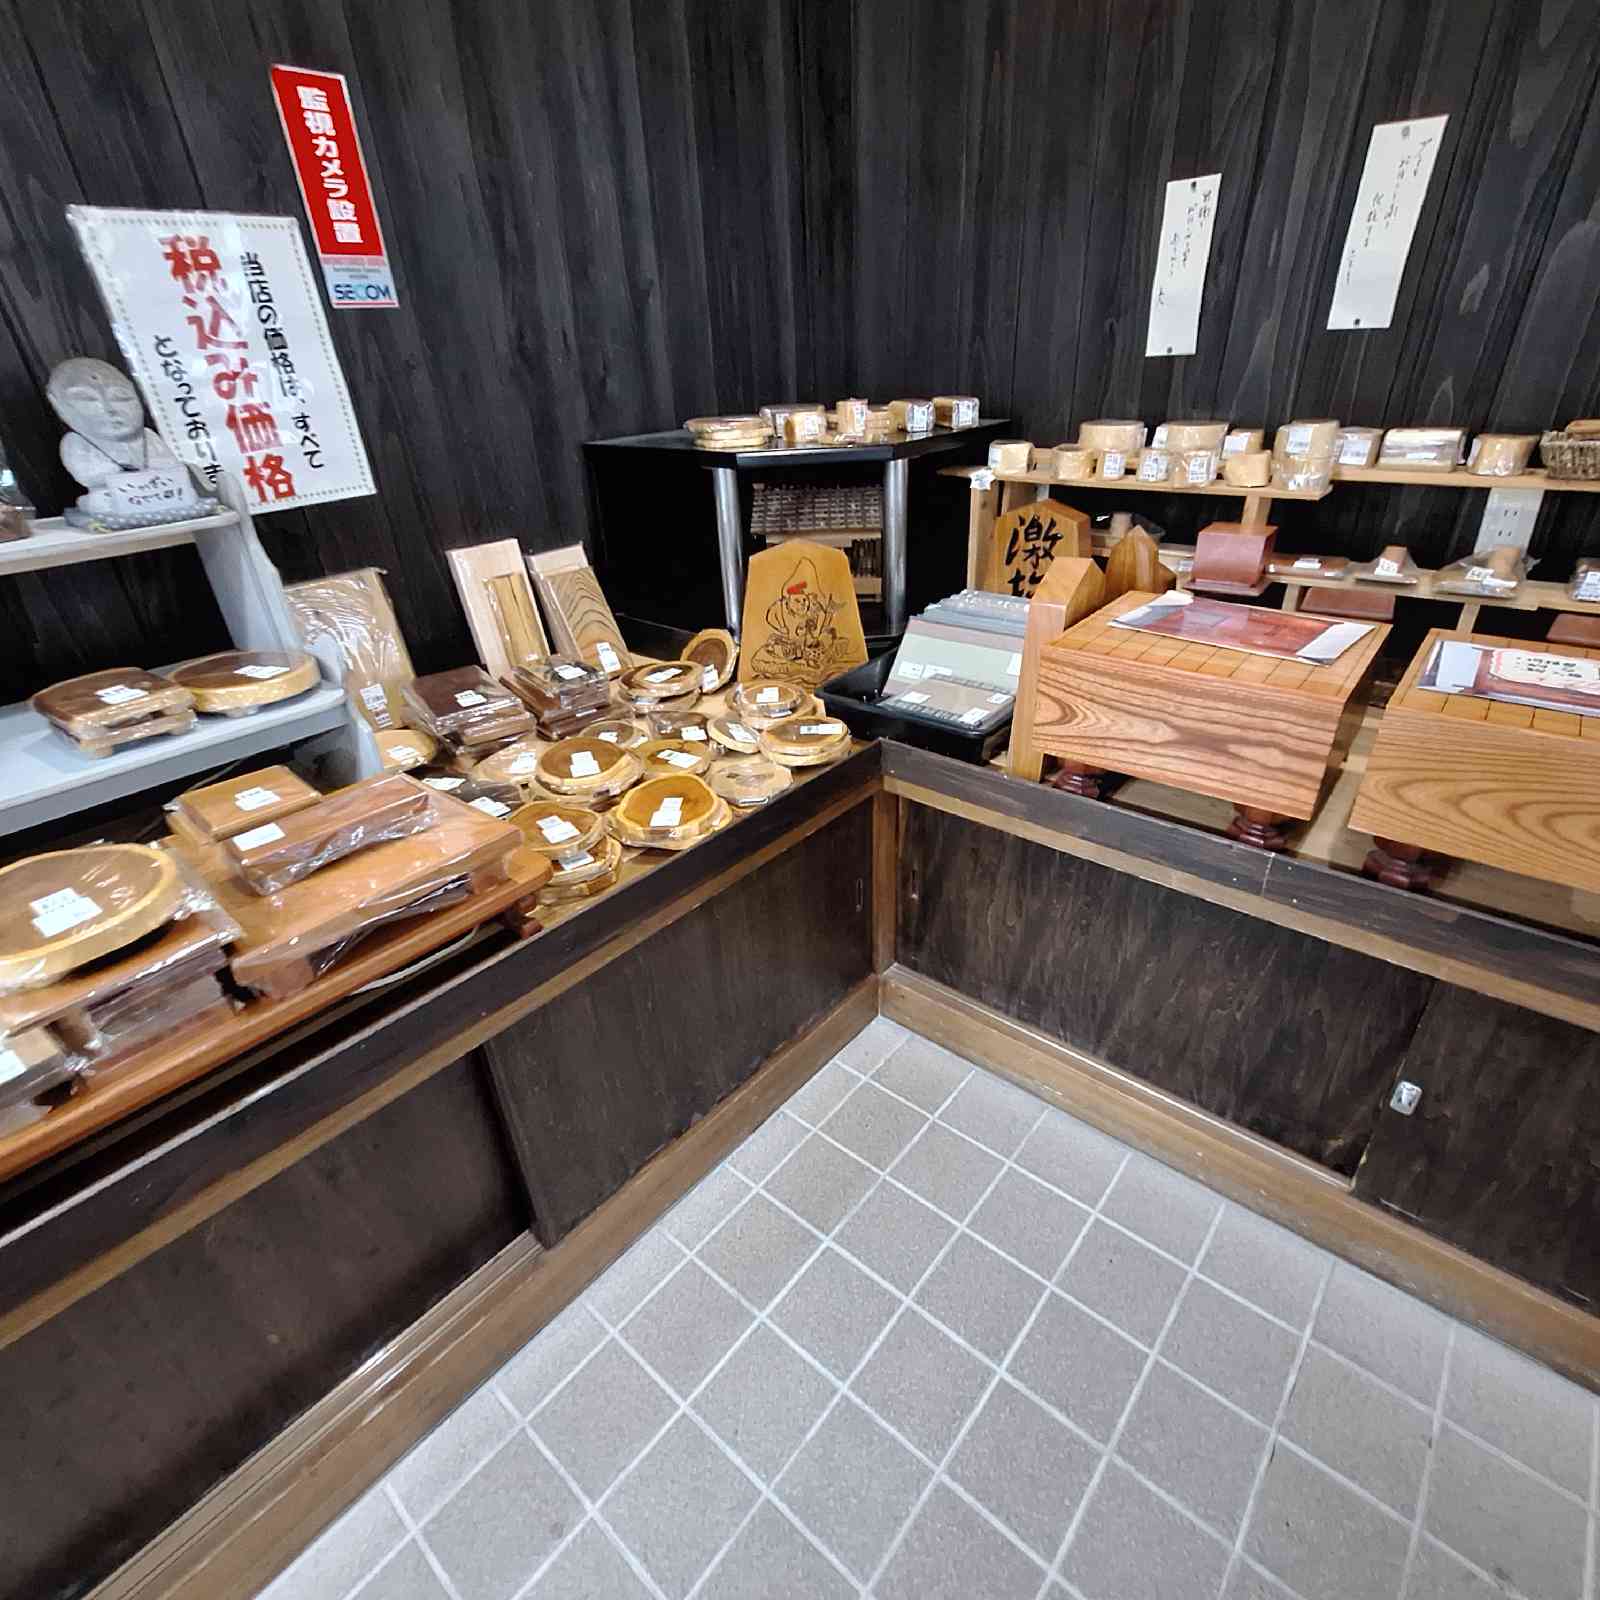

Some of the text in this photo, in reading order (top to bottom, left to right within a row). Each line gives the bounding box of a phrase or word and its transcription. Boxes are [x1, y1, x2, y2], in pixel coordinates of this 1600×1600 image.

[296, 86, 364, 243] 監視カメラ設置
[159, 234, 296, 503] 税込み価格
[334, 284, 393, 301] SECOM
